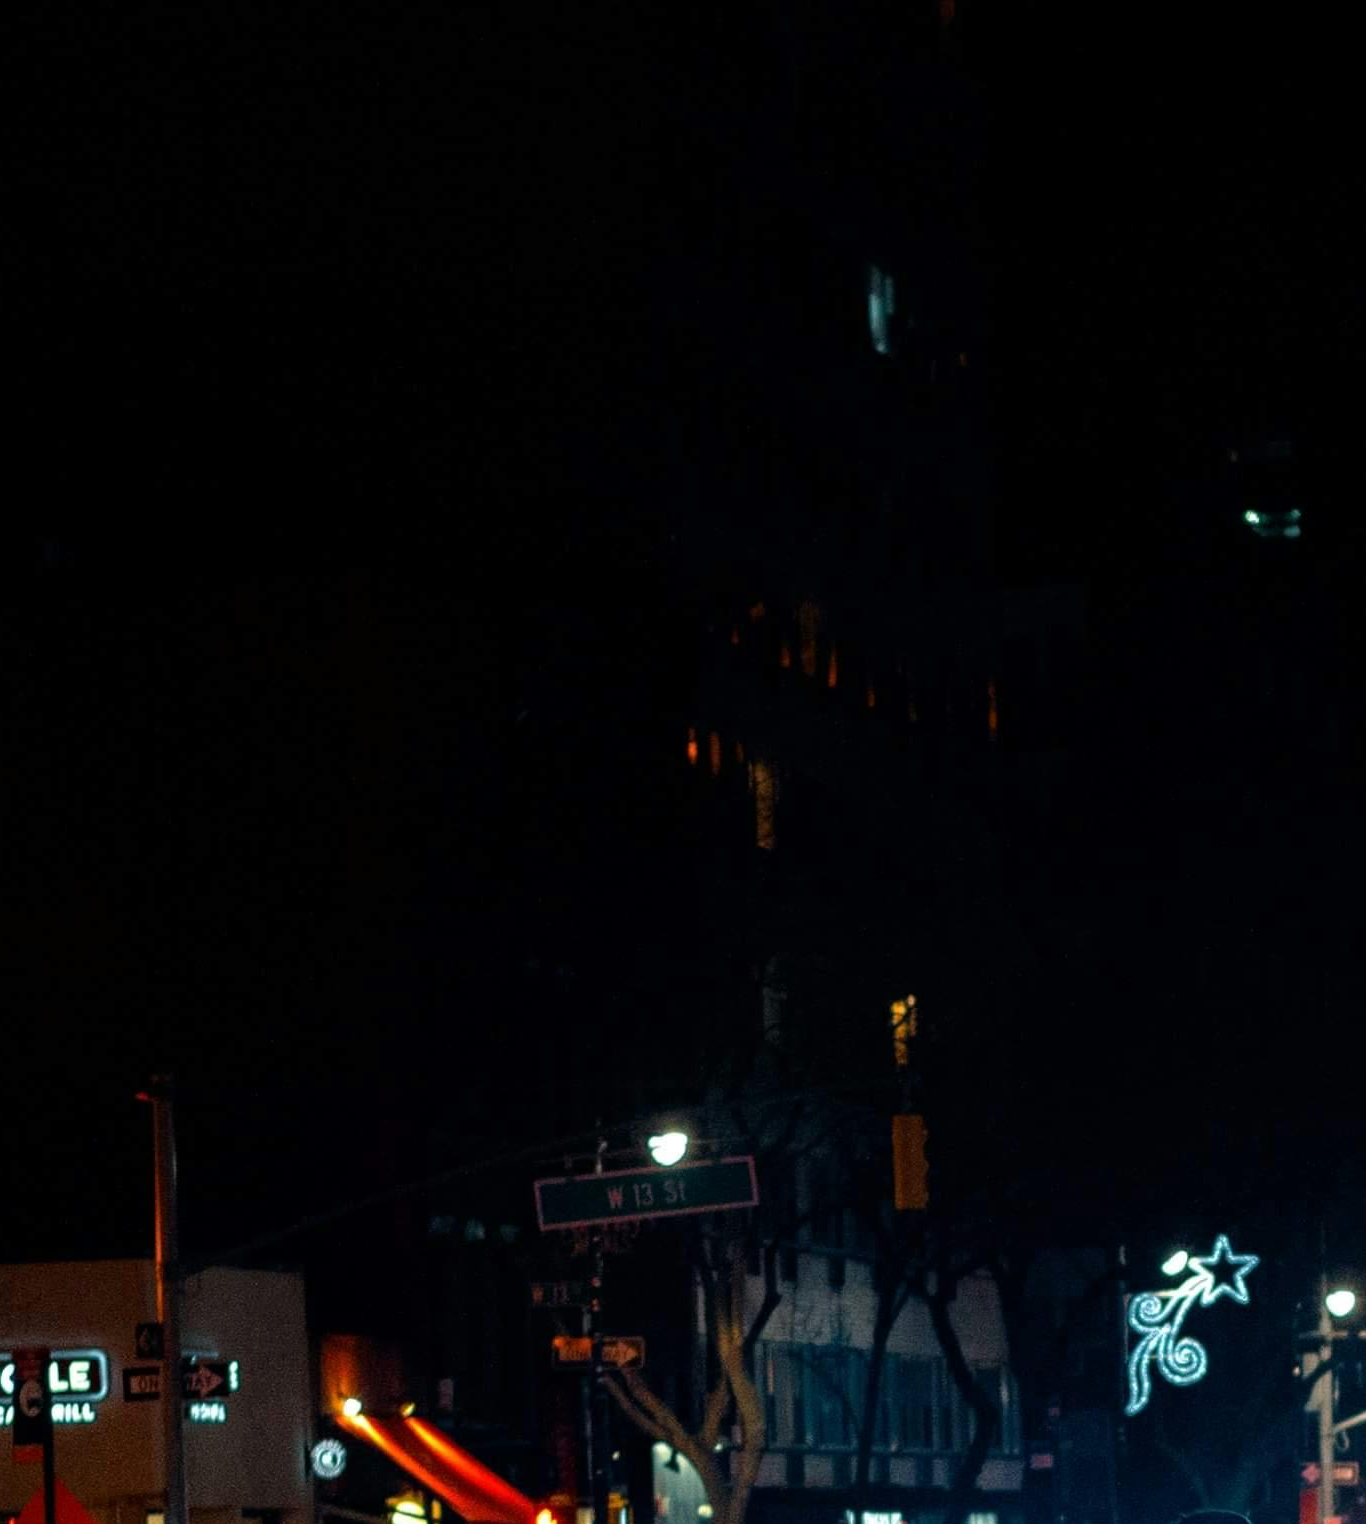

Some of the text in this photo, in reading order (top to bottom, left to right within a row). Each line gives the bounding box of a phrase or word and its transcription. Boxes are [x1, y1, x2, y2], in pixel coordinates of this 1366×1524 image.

[606, 1178, 687, 1209] W 13 St
